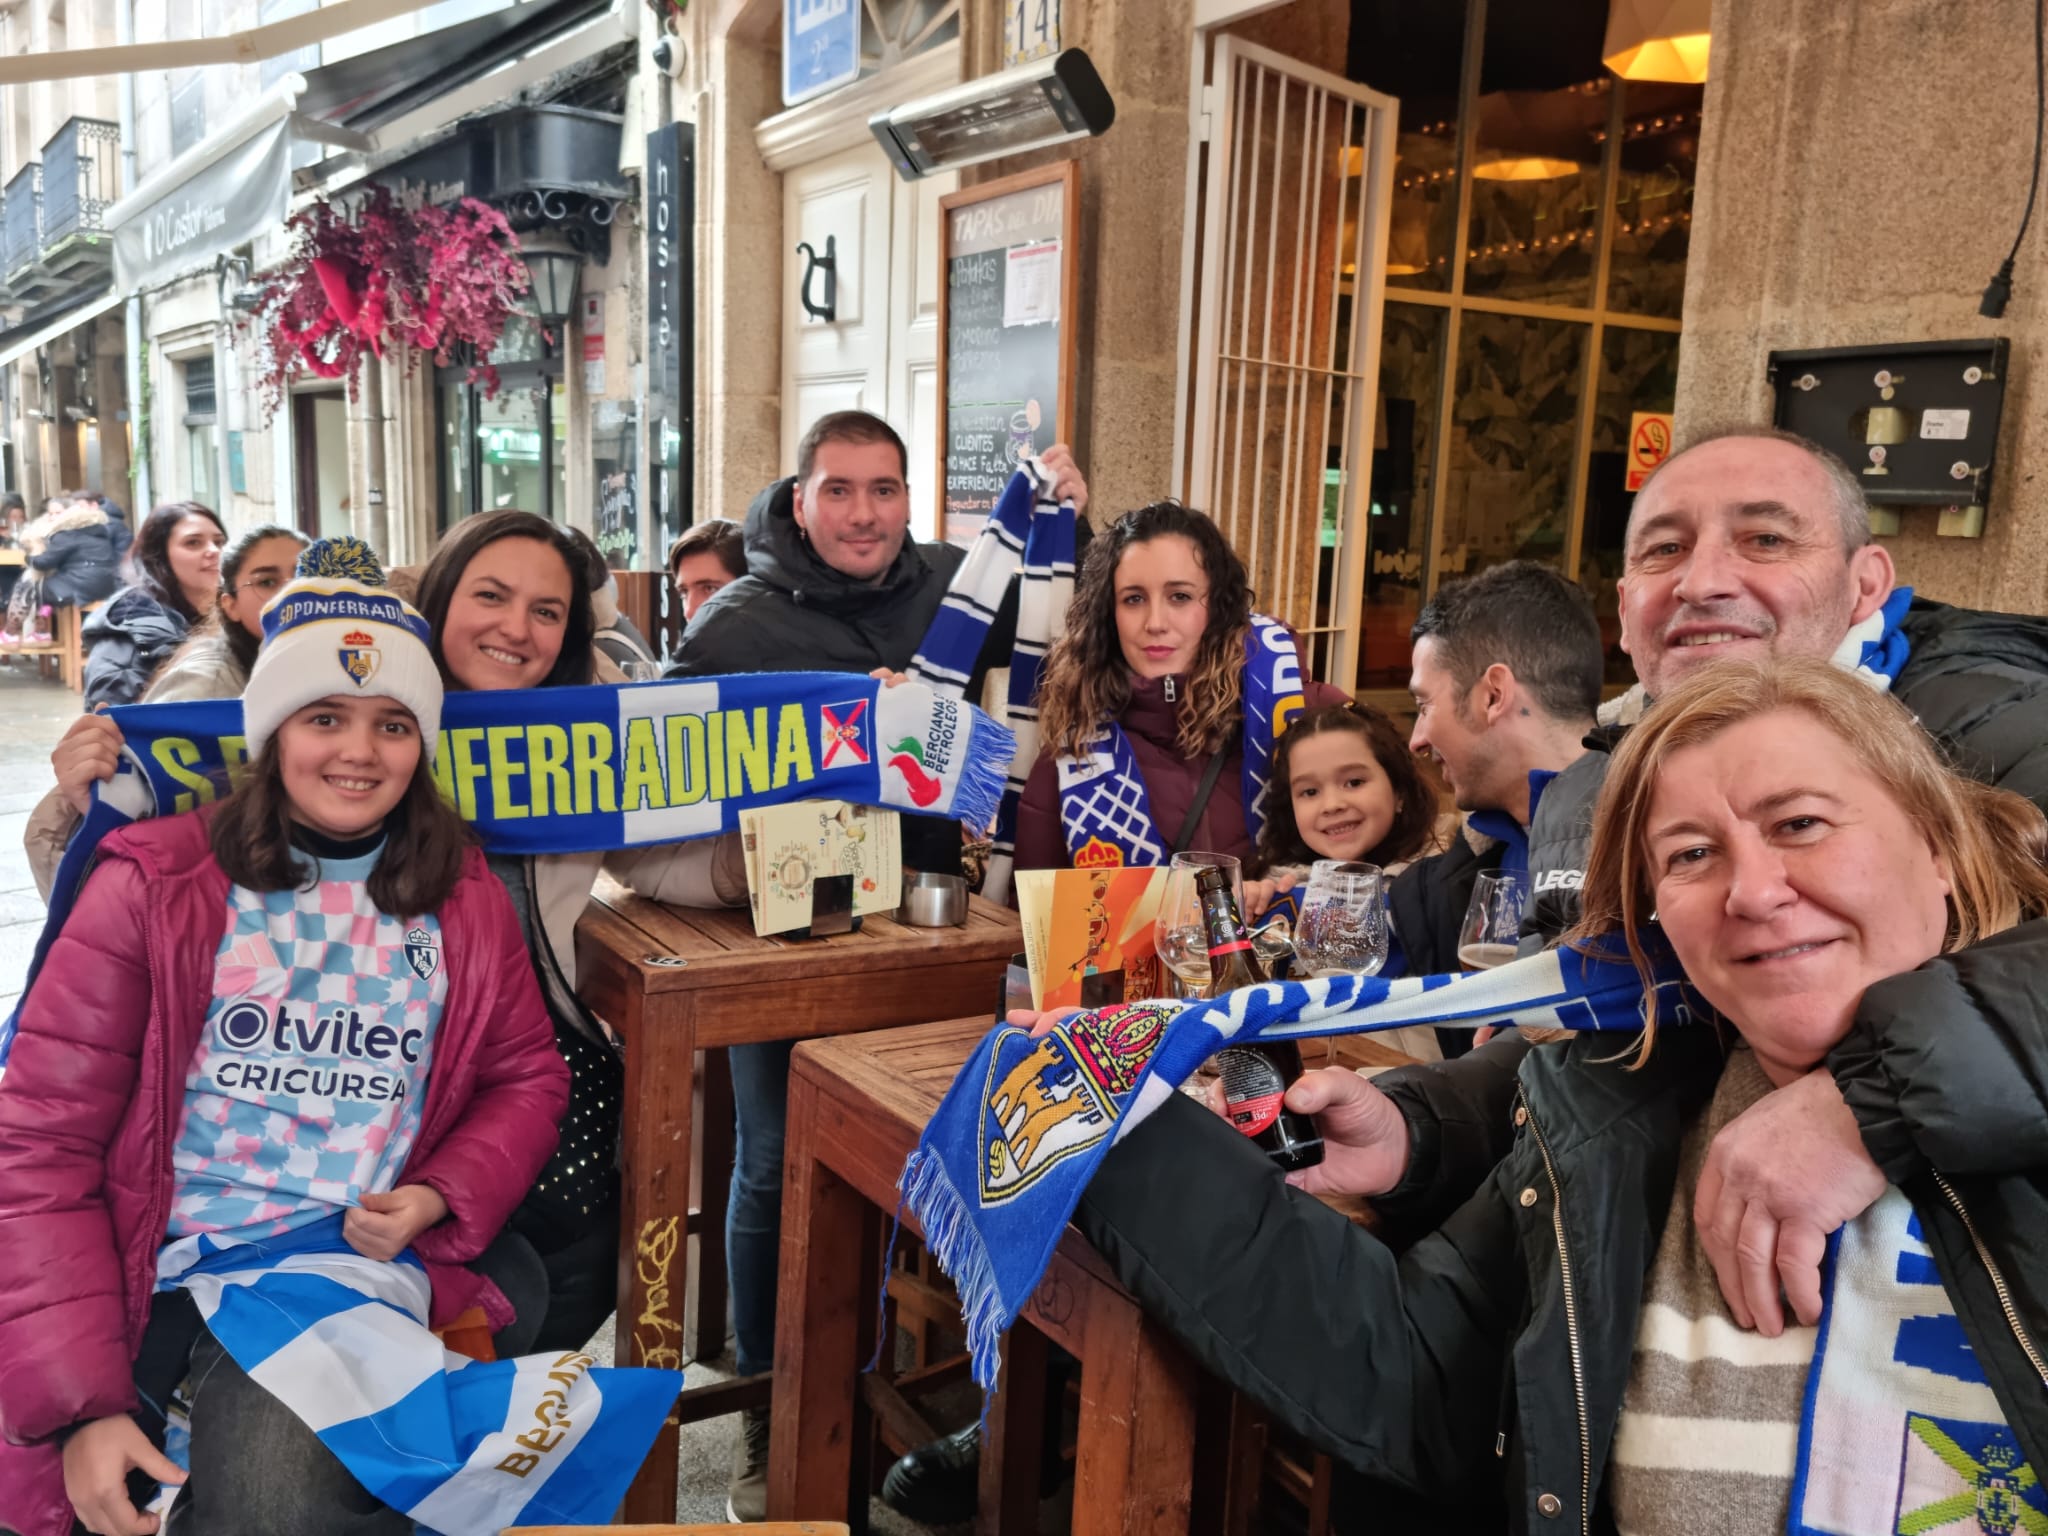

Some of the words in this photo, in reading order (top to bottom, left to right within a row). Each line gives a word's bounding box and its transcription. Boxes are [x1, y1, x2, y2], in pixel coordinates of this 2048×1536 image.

[1016, 0, 1048, 51] 14
[955, 203, 1006, 241] TAPAS
[954, 433, 994, 453] CLIENTES
[946, 475, 1005, 492] EXPERIENCIA
[923, 700, 945, 770] BERCIANA
[935, 698, 958, 775] PETROLEOS
[1533, 869, 1588, 894] LEG
[273, 1005, 423, 1063] tvitec
[216, 1062, 405, 1102] CRICURSA
